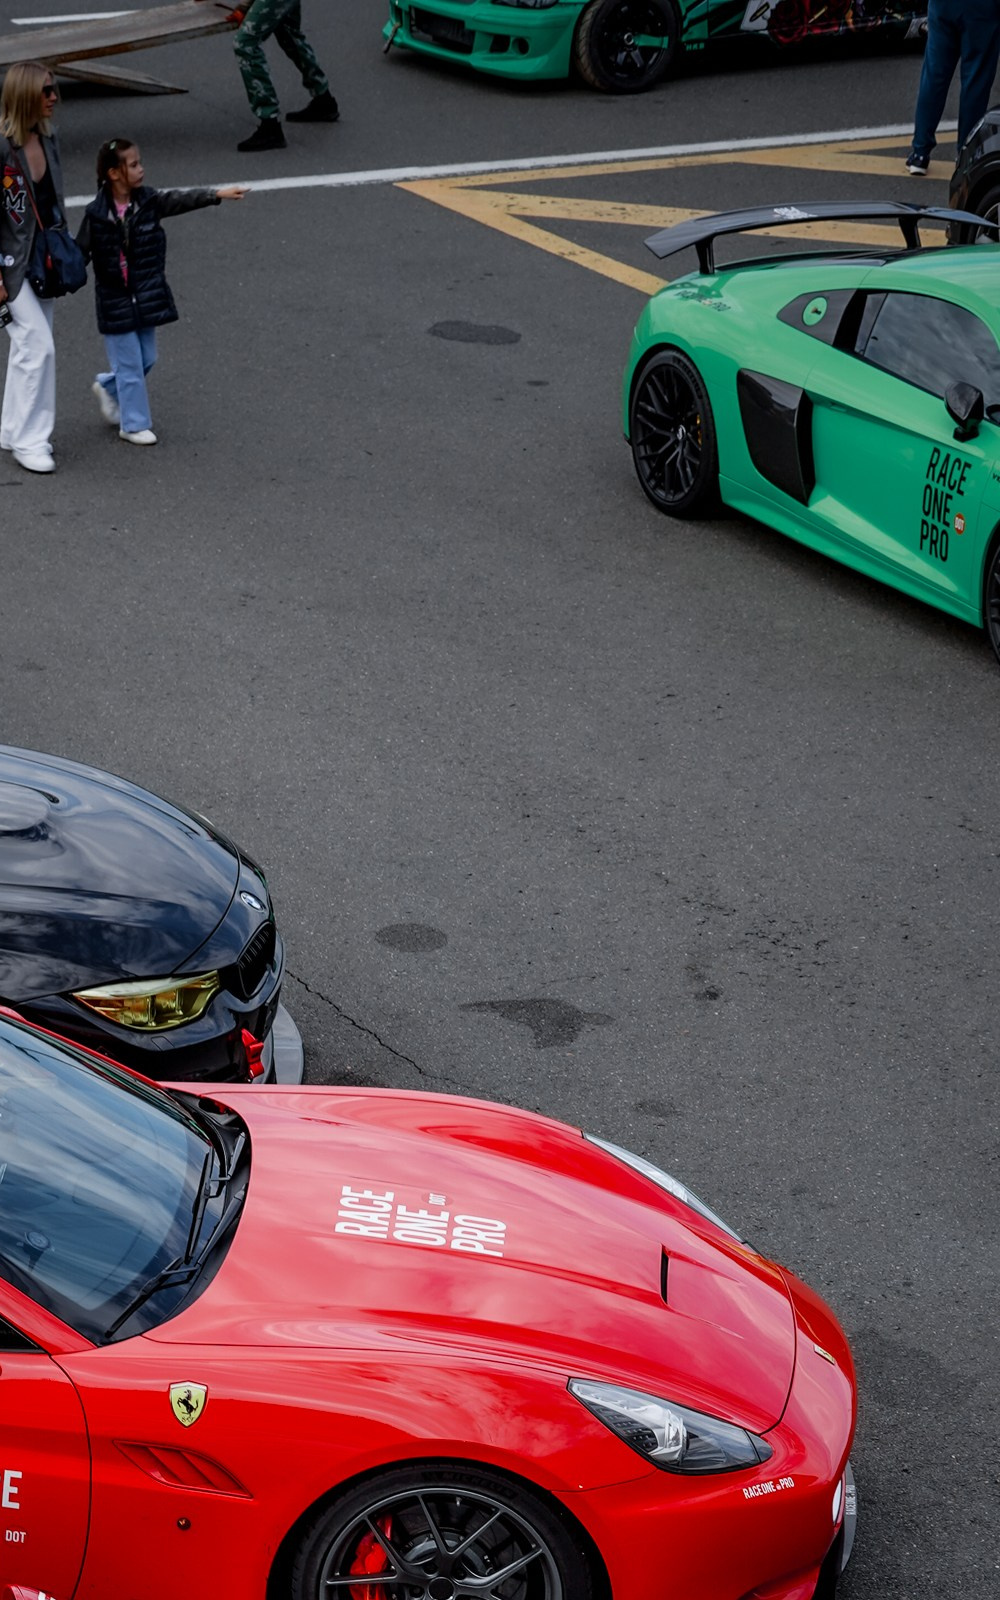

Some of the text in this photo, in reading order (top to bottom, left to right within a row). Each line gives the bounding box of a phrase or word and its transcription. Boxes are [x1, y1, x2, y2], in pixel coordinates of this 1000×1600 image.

[3, 190, 27, 212] M
[926, 447, 972, 496] RACE
[922, 484, 953, 528] ONE
[920, 518, 949, 562] PRO
[335, 1185, 395, 1239] RACE
[393, 1205, 450, 1246] ONE
[450, 1215, 507, 1257] PRO
[778, 1476, 795, 1490] PRO
[5, 1529, 27, 1544] DOT
